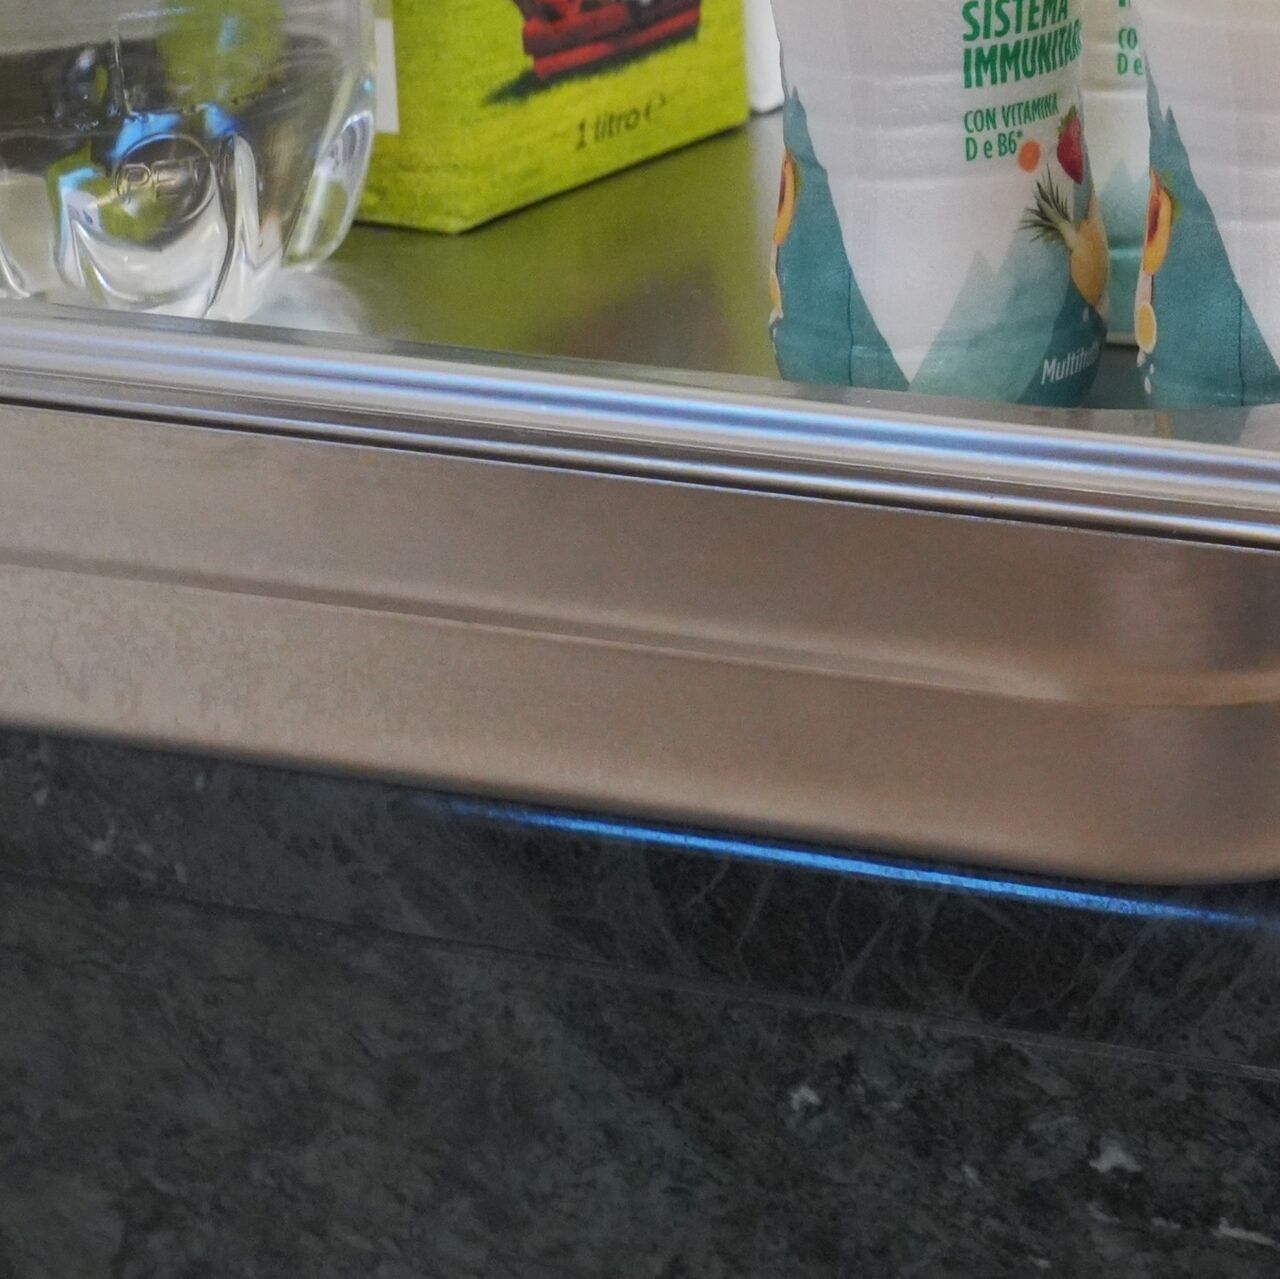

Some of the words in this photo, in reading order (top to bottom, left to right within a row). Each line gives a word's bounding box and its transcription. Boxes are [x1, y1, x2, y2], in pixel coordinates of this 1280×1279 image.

[594, 107, 640, 142] litro
[964, 107, 997, 133] CON
[1002, 92, 1059, 128] VITAMINA
[965, 137, 978, 161] D
[984, 140, 993, 158] e
